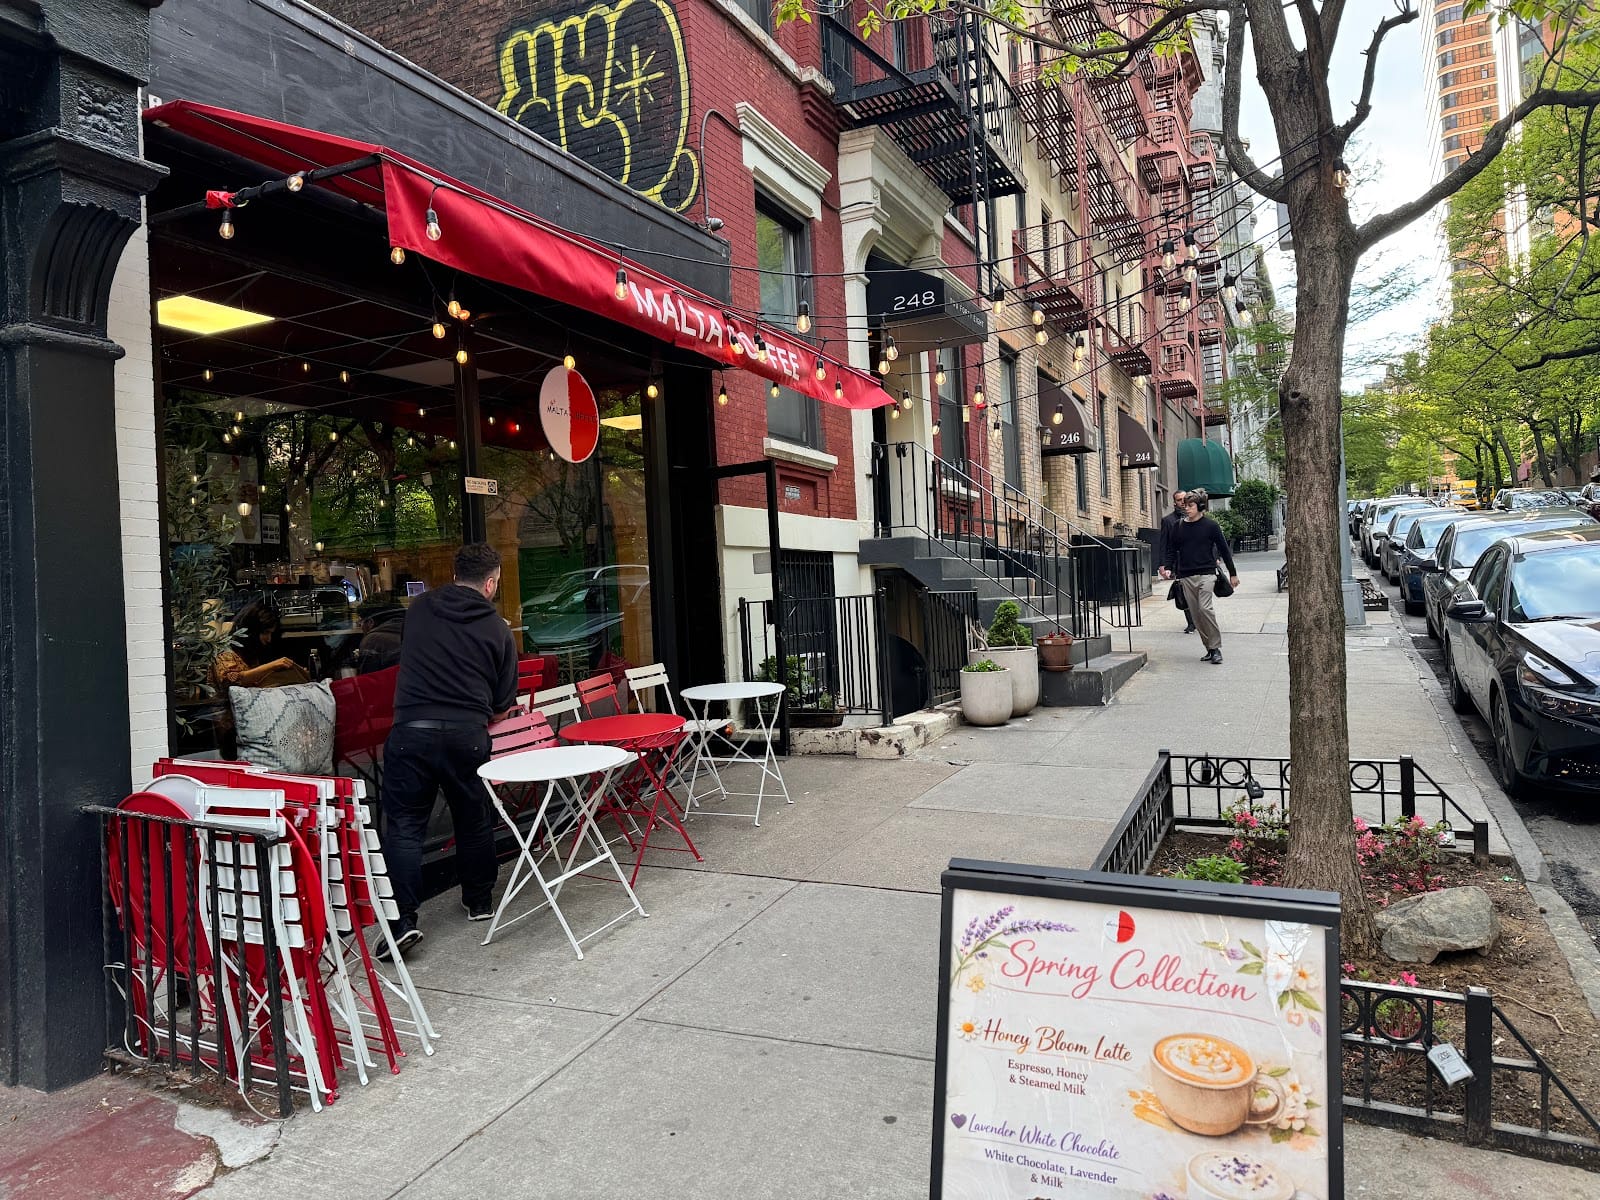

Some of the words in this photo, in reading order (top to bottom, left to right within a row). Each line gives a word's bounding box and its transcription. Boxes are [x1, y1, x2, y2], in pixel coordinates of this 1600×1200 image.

[893, 291, 935, 311] 248
[628, 281, 723, 349] MALTA
[727, 324, 800, 381] COFEE
[546, 405, 568, 417] MALTA
[1060, 432, 1080, 445] 246
[1135, 452, 1151, 462] 244
[1000, 939, 1102, 999] Spring
[1109, 948, 1257, 1001] Collection
[984, 1017, 1031, 1055] Honey
[1035, 1026, 1090, 1056] Bloom
[1094, 1035, 1133, 1062] Latte
[1008, 1059, 1054, 1076] Espresso,
[1056, 1067, 1089, 1083] Honey
[1009, 1074, 1017, 1084] &
[1019, 1075, 1061, 1091] Steamed
[1063, 1084, 1086, 1096] Milk
[968, 1113, 1016, 1137] Lavender
[1019, 1125, 1057, 1148] White
[1060, 1131, 1121, 1160] Chocolate
[984, 1148, 1014, 1164] White
[1016, 1155, 1068, 1176] Chocolate,
[1069, 1166, 1118, 1185] Lavender
[1030, 1173, 1038, 1183] &
[1040, 1175, 1063, 1189] Milk
